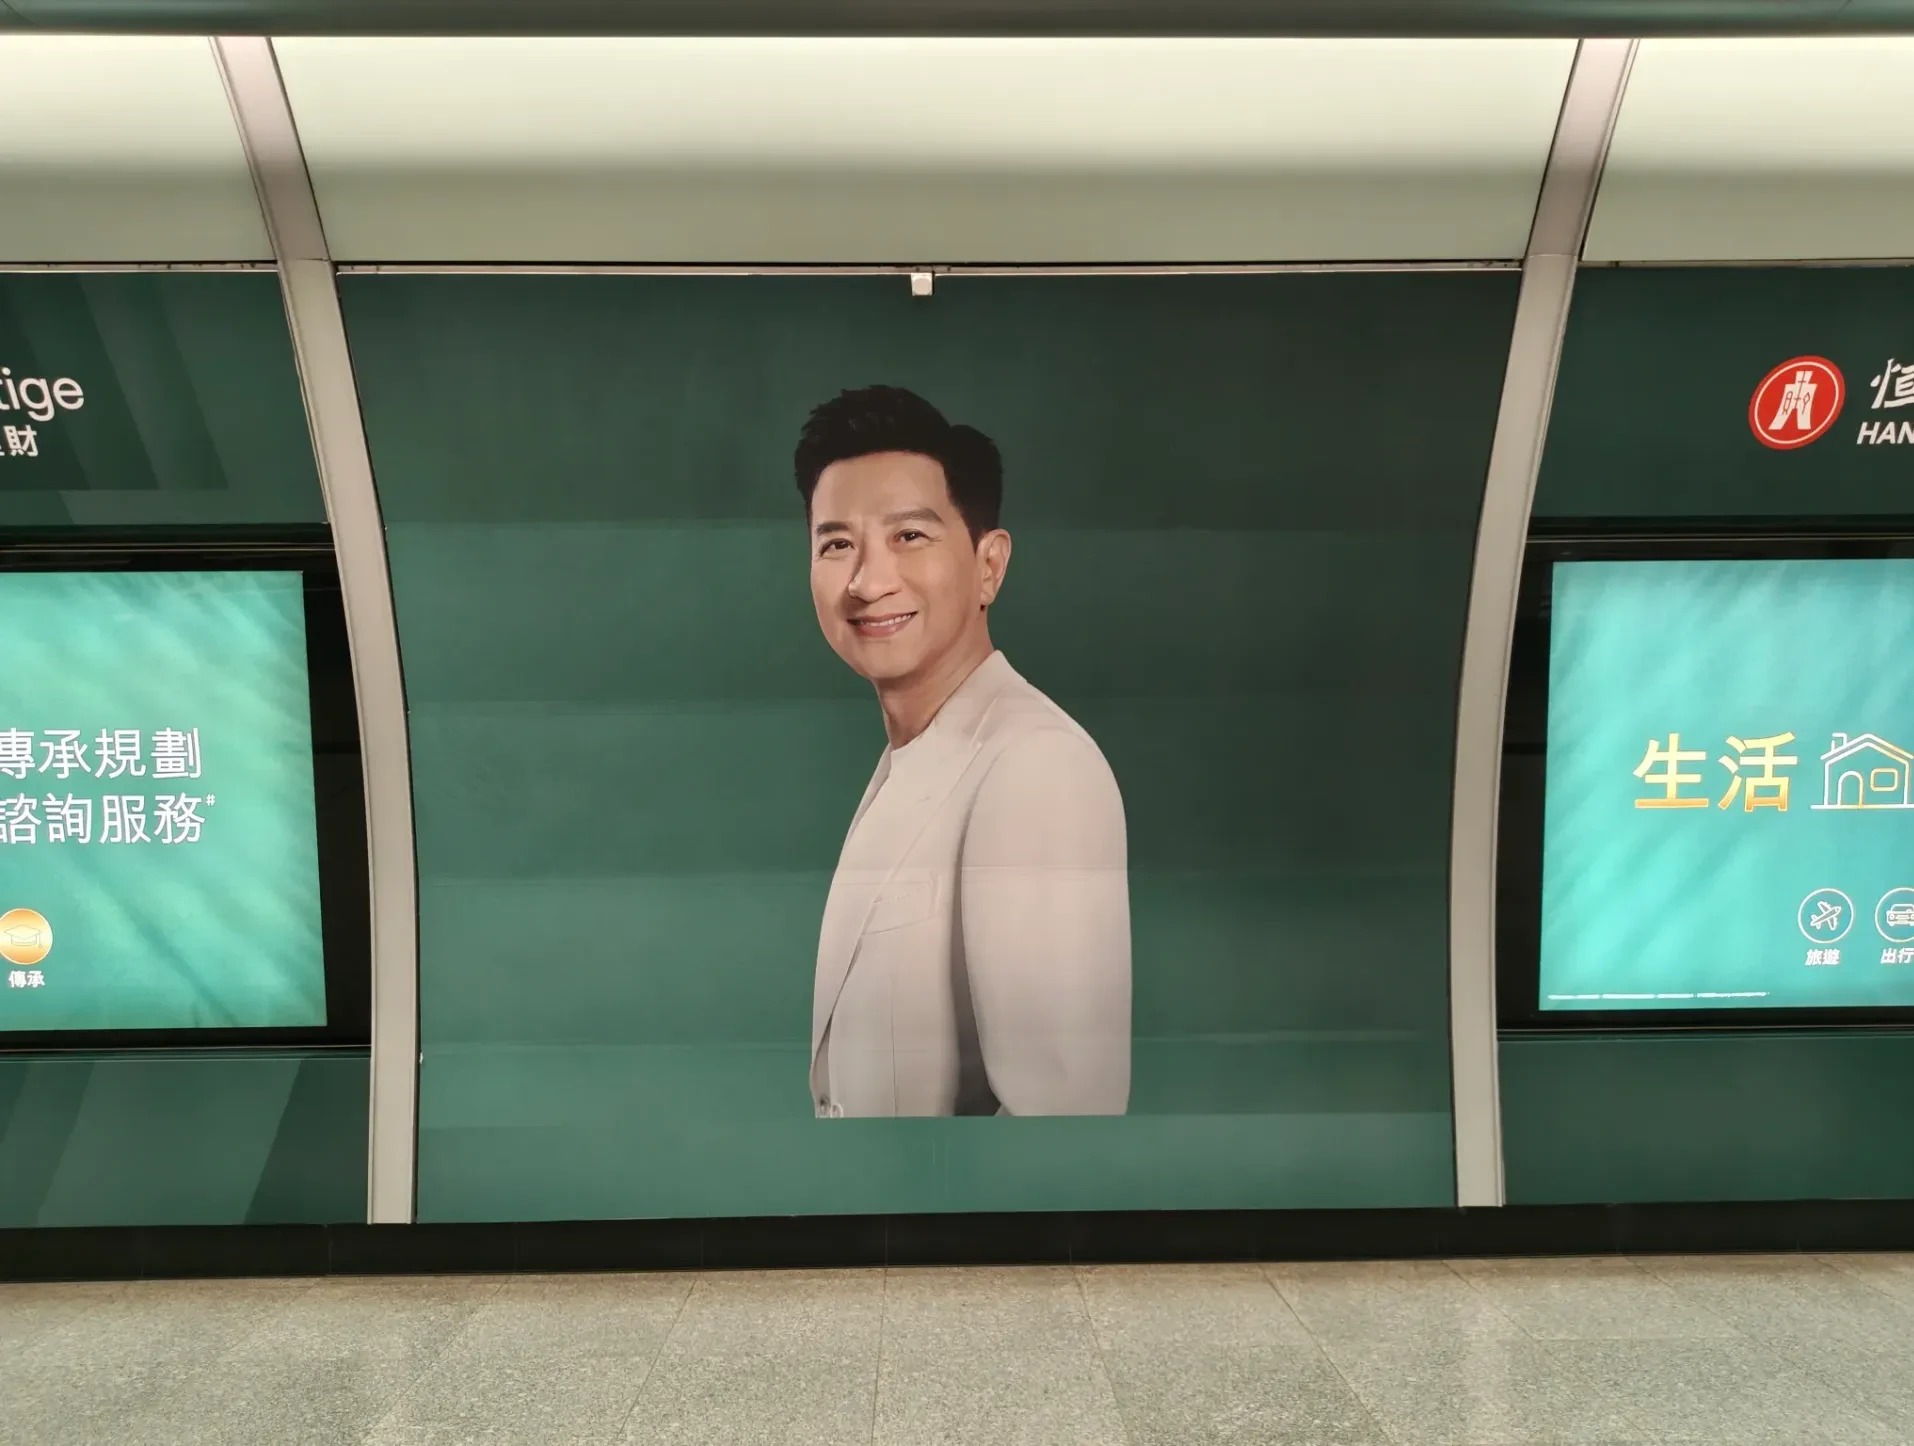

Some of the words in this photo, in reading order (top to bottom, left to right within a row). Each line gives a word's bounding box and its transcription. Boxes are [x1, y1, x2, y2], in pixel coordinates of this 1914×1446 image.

[0, 424, 39, 457] 財
[0, 727, 202, 780] 傳承規劃
[1632, 731, 1799, 813] 生活
[1880, 947, 1914, 964] 出行
[8, 970, 46, 988] 傳承
